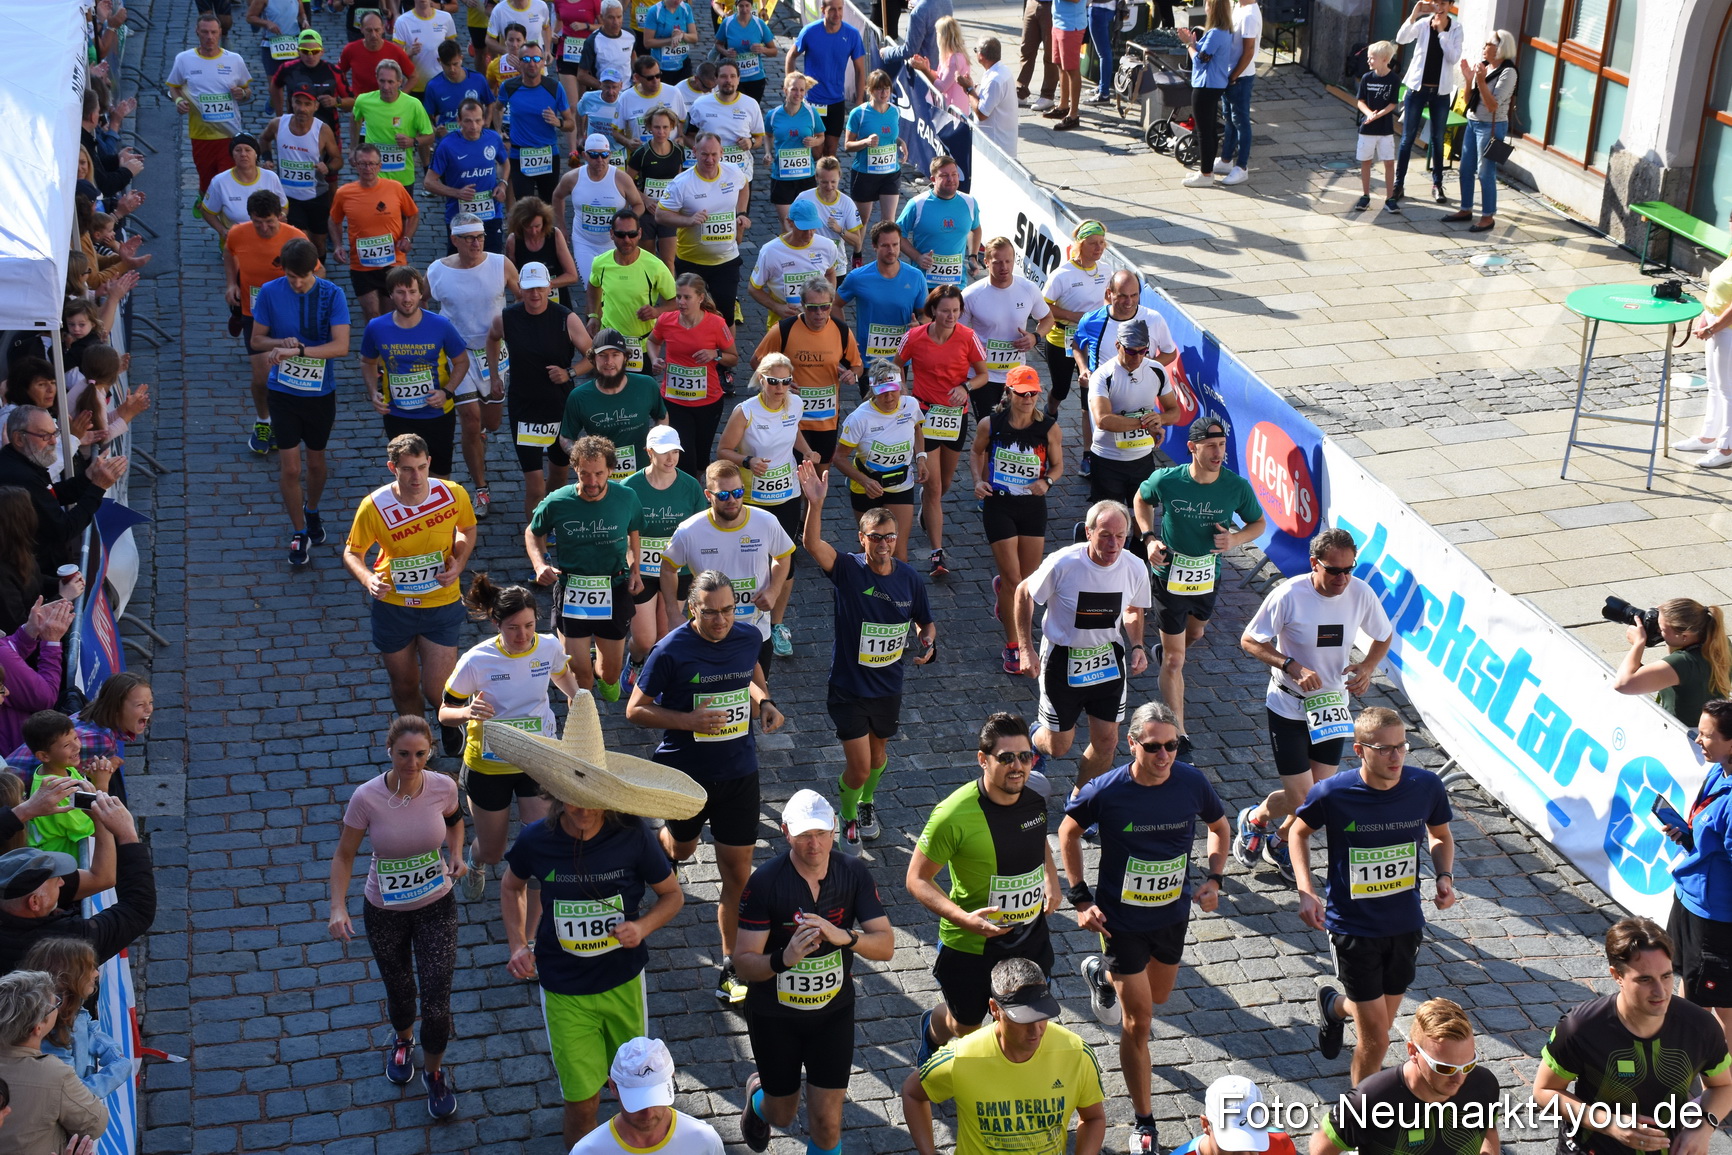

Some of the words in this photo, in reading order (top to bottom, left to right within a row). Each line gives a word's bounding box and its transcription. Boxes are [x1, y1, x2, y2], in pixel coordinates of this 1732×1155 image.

[273, 43, 296, 52] 1020
[665, 46, 687, 55] 2468
[204, 103, 230, 113] 2124
[382, 153, 403, 163] 816
[525, 157, 549, 167] 2074
[783, 158, 808, 169] 2469
[872, 155, 894, 165] 2467
[284, 169, 311, 181] 2736
[461, 166, 494, 180] #LÄUFT
[463, 202, 490, 213] 2312
[585, 214, 613, 226] 2354
[706, 223, 732, 234] 1095
[361, 245, 392, 259] 2475
[930, 264, 959, 276] 2465
[870, 325, 906, 335] BOCK
[390, 343, 436, 351] NEUMARKTER
[873, 335, 902, 347] 1178
[873, 347, 898, 355] PATRICK
[991, 350, 1019, 363] 1177
[283, 362, 320, 381] 2274
[668, 365, 703, 378] BOCK
[286, 377, 312, 388] JULIAN
[393, 374, 426, 384] BOCK
[670, 375, 702, 390] 1231
[395, 383, 430, 398] 2220
[675, 390, 697, 398] SIGRID
[800, 386, 832, 398] BOCK
[803, 397, 832, 412] 2751
[931, 404, 961, 416] BOCK
[524, 421, 558, 436] 1404
[929, 415, 958, 430] 1365
[874, 442, 906, 454] BOCK
[871, 452, 905, 466] 2749
[998, 449, 1034, 464] BOCK
[999, 460, 1035, 478] 2345
[1250, 427, 1312, 524] Hervis
[756, 477, 790, 492] 2663
[1002, 474, 1029, 485] ULRIKE
[760, 490, 787, 499] MARGIT
[391, 521, 423, 542] MAX
[425, 506, 459, 530] BÖGL
[394, 554, 438, 569] BOCK
[1177, 557, 1213, 568] BOCK
[397, 566, 440, 584] 2377
[1175, 568, 1212, 584] 1235
[571, 576, 606, 588] BOCK
[569, 589, 606, 606] 2767
[865, 623, 906, 636] BOCK
[867, 635, 904, 653] 1183
[868, 653, 898, 664] JÜRGEN
[1073, 653, 1110, 675] 2135
[700, 674, 723, 685] GOSSEN
[1082, 671, 1105, 683] ALOIS
[1306, 693, 1342, 710] BOCK
[1311, 707, 1349, 727] 2430
[1319, 724, 1349, 737] MARTIN
[1133, 823, 1156, 833] GOSSEN
[1156, 820, 1189, 832] METRAWATT
[1356, 823, 1384, 833] GOSSEN
[1386, 818, 1424, 831] METRAWATT
[1354, 845, 1411, 862] BOCK
[380, 853, 434, 874] BOCK
[1131, 859, 1183, 874] BOCK
[555, 872, 583, 884] GOSSEN
[583, 868, 625, 884] METRAWATT
[1358, 860, 1410, 881] 1187
[386, 866, 438, 891] 2246
[994, 871, 1044, 890] BOCK
[1132, 873, 1179, 892] 1184
[393, 882, 436, 902] LARISSA
[1366, 880, 1402, 893] OLIVER
[997, 886, 1042, 909] 1109
[1133, 892, 1173, 903] MARKUS
[561, 901, 615, 916] BOCK
[1002, 908, 1035, 921] ROMAN
[563, 917, 618, 938] 1186
[574, 939, 609, 952] ARMIN
[785, 971, 838, 992] 1339
[789, 992, 832, 1005] MARKUS
[975, 1099, 1012, 1117] BMW
[1014, 1095, 1066, 1114] BERLIN
[978, 1111, 1064, 1133] MARATHON
